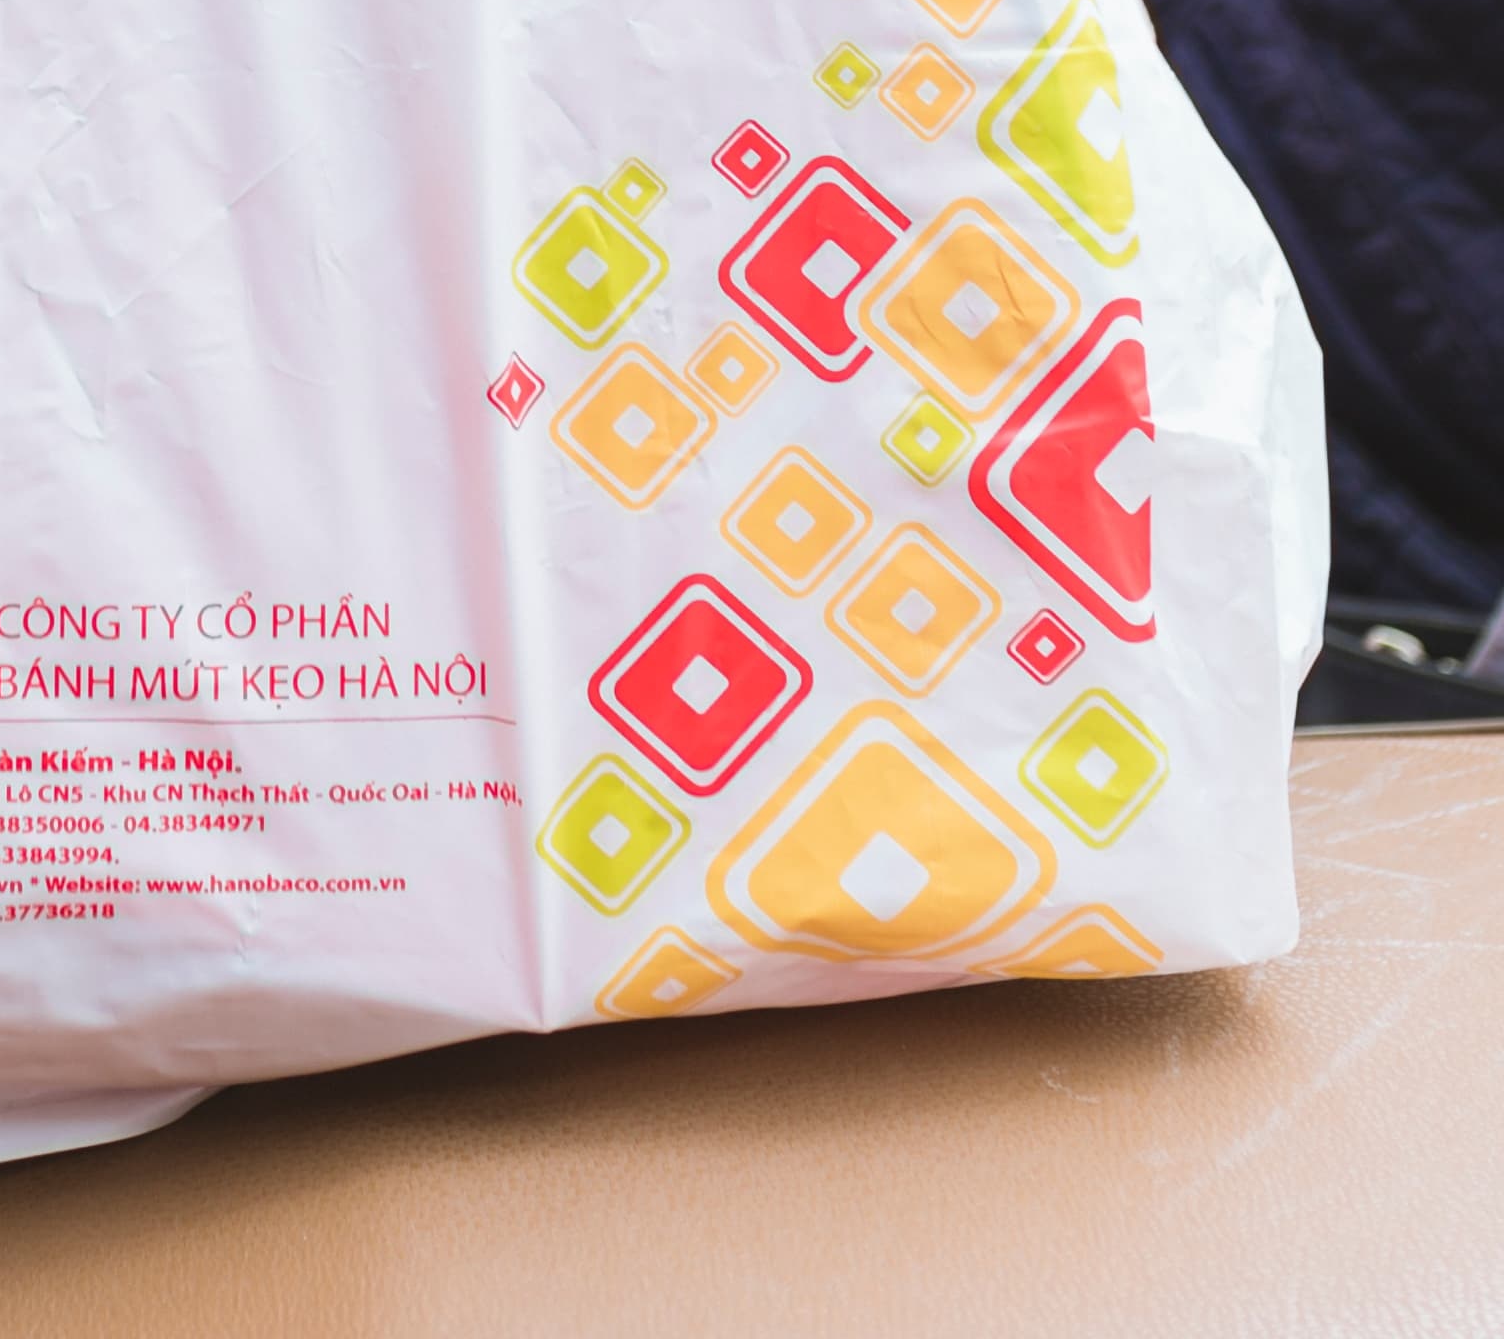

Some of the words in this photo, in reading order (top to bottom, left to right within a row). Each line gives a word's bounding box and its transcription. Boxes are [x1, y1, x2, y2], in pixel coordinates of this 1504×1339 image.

[131, 604, 184, 640] TY
[197, 590, 257, 640] CỔ
[272, 592, 391, 639] PHẦN
[131, 659, 228, 701] MỨT
[242, 664, 324, 709] KẸO
[339, 655, 399, 699] HÀ
[414, 653, 486, 705] NỘI
[42, 747, 114, 773] Kiếm
[139, 748, 176, 772] Hà
[184, 748, 242, 779] Nội.
[6, 785, 32, 803] Lô
[38, 785, 83, 803] CN5
[103, 785, 147, 803] Khu
[153, 785, 184, 802] CN
[189, 783, 255, 807] Thạch
[260, 781, 309, 803] Thất
[328, 781, 386, 805] Quốc
[392, 783, 429, 801] Oai
[448, 781, 476, 800] Hà
[124, 814, 265, 834] 04.38344971
[45, 875, 140, 894] Website:
[147, 875, 406, 894] www.hanobaco.com.vn
